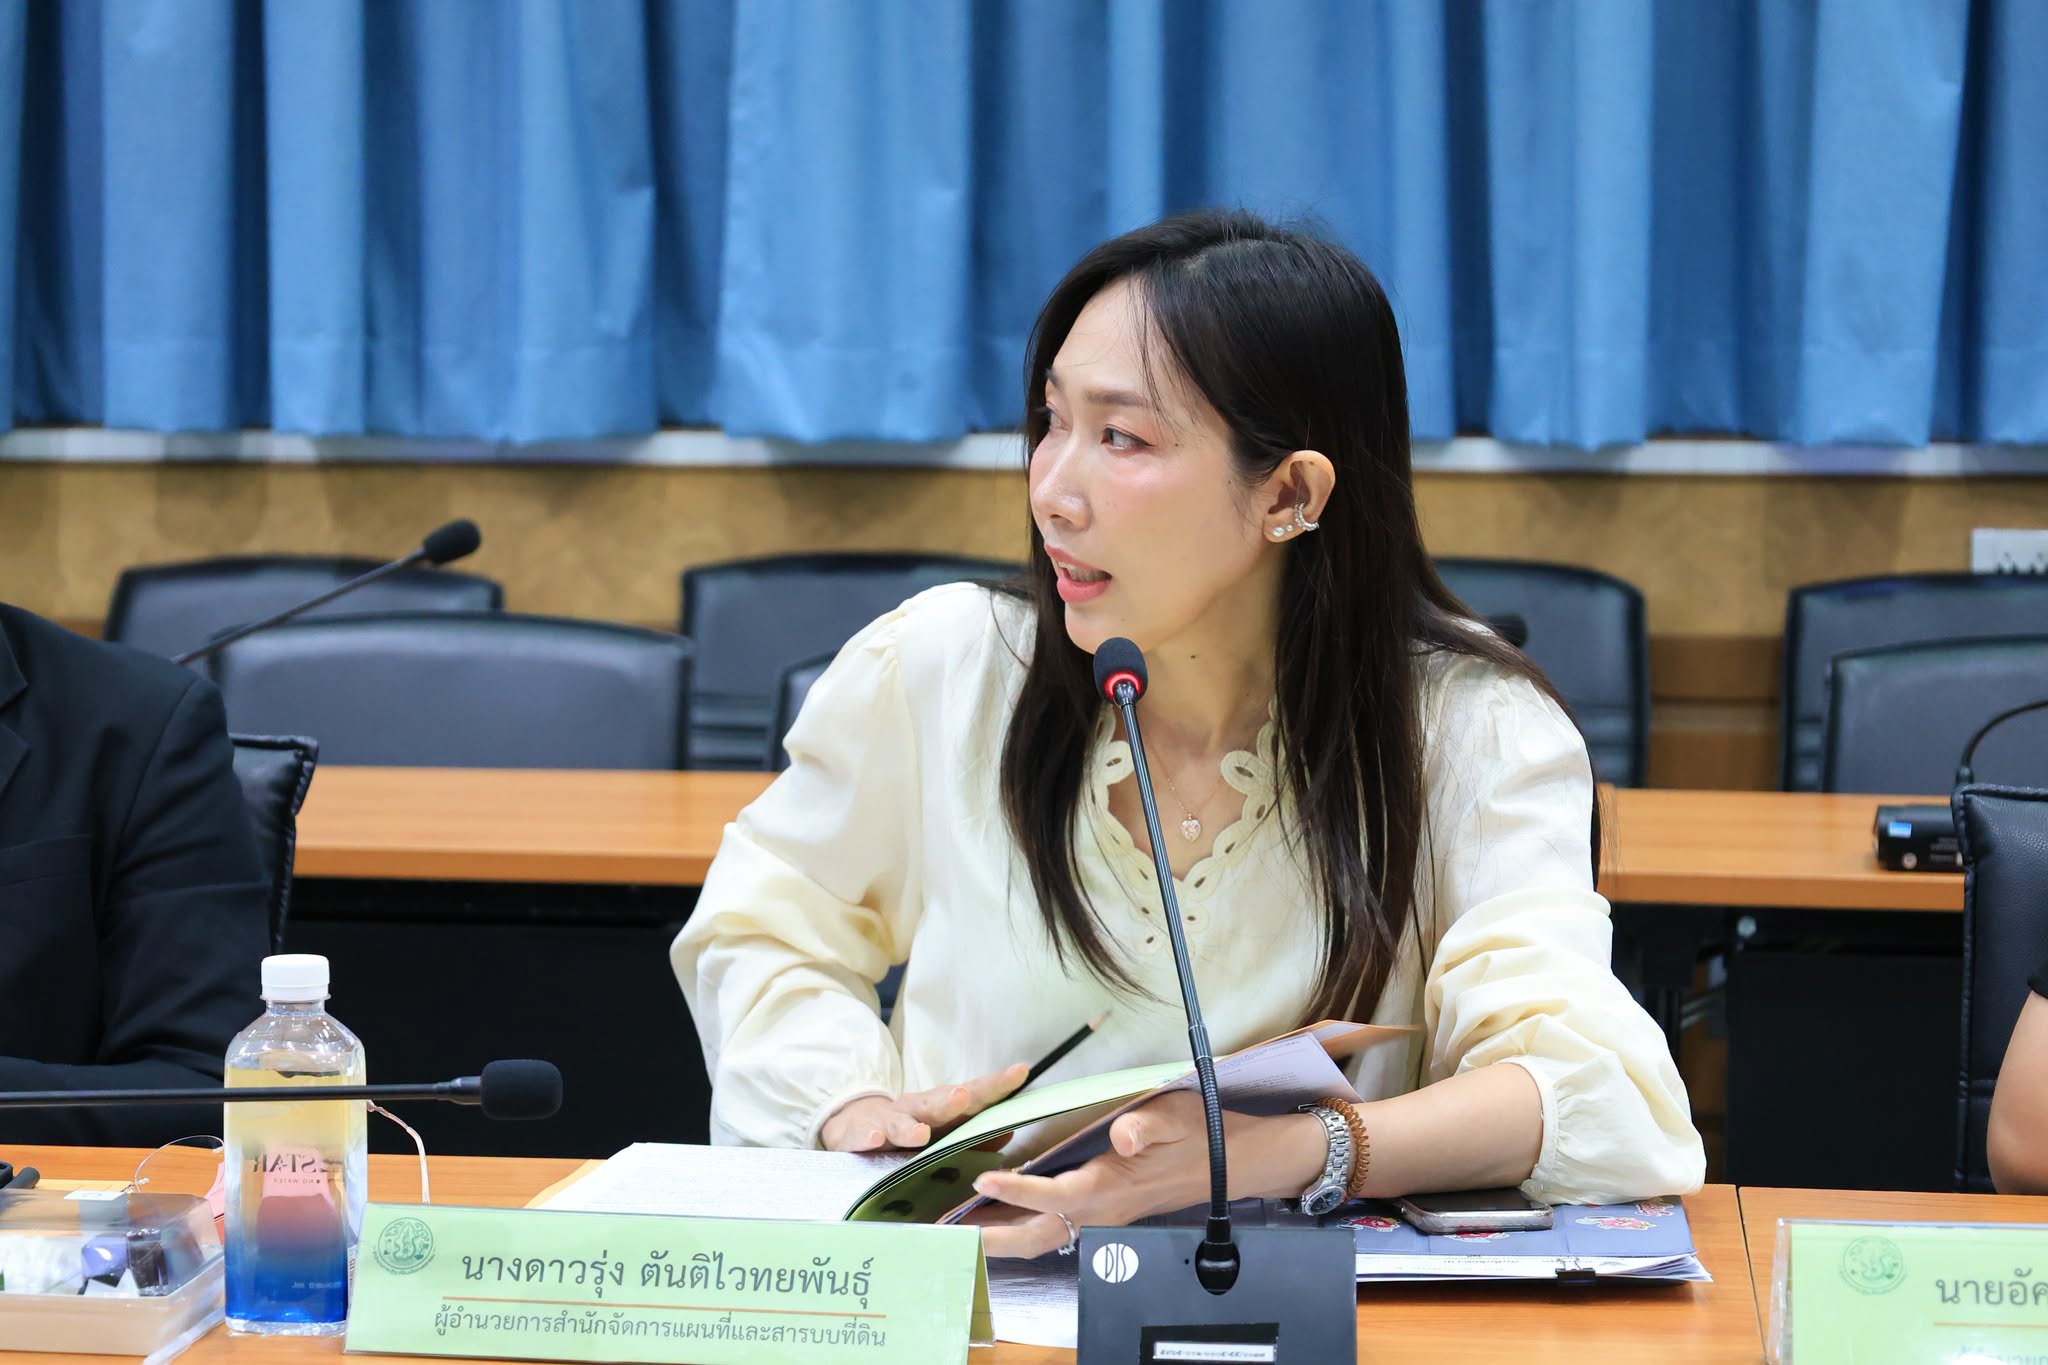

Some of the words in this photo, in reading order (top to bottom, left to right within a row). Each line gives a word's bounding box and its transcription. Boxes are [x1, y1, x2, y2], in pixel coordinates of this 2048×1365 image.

[462, 1249, 625, 1299] นางดาวรุ่ง
[640, 1249, 875, 1310] ตันติไวทยพันธุ์
[434, 1303, 887, 1347] ผู้อำนวยการสำนักจัดการแผนที่และสารบบที่ดิน
